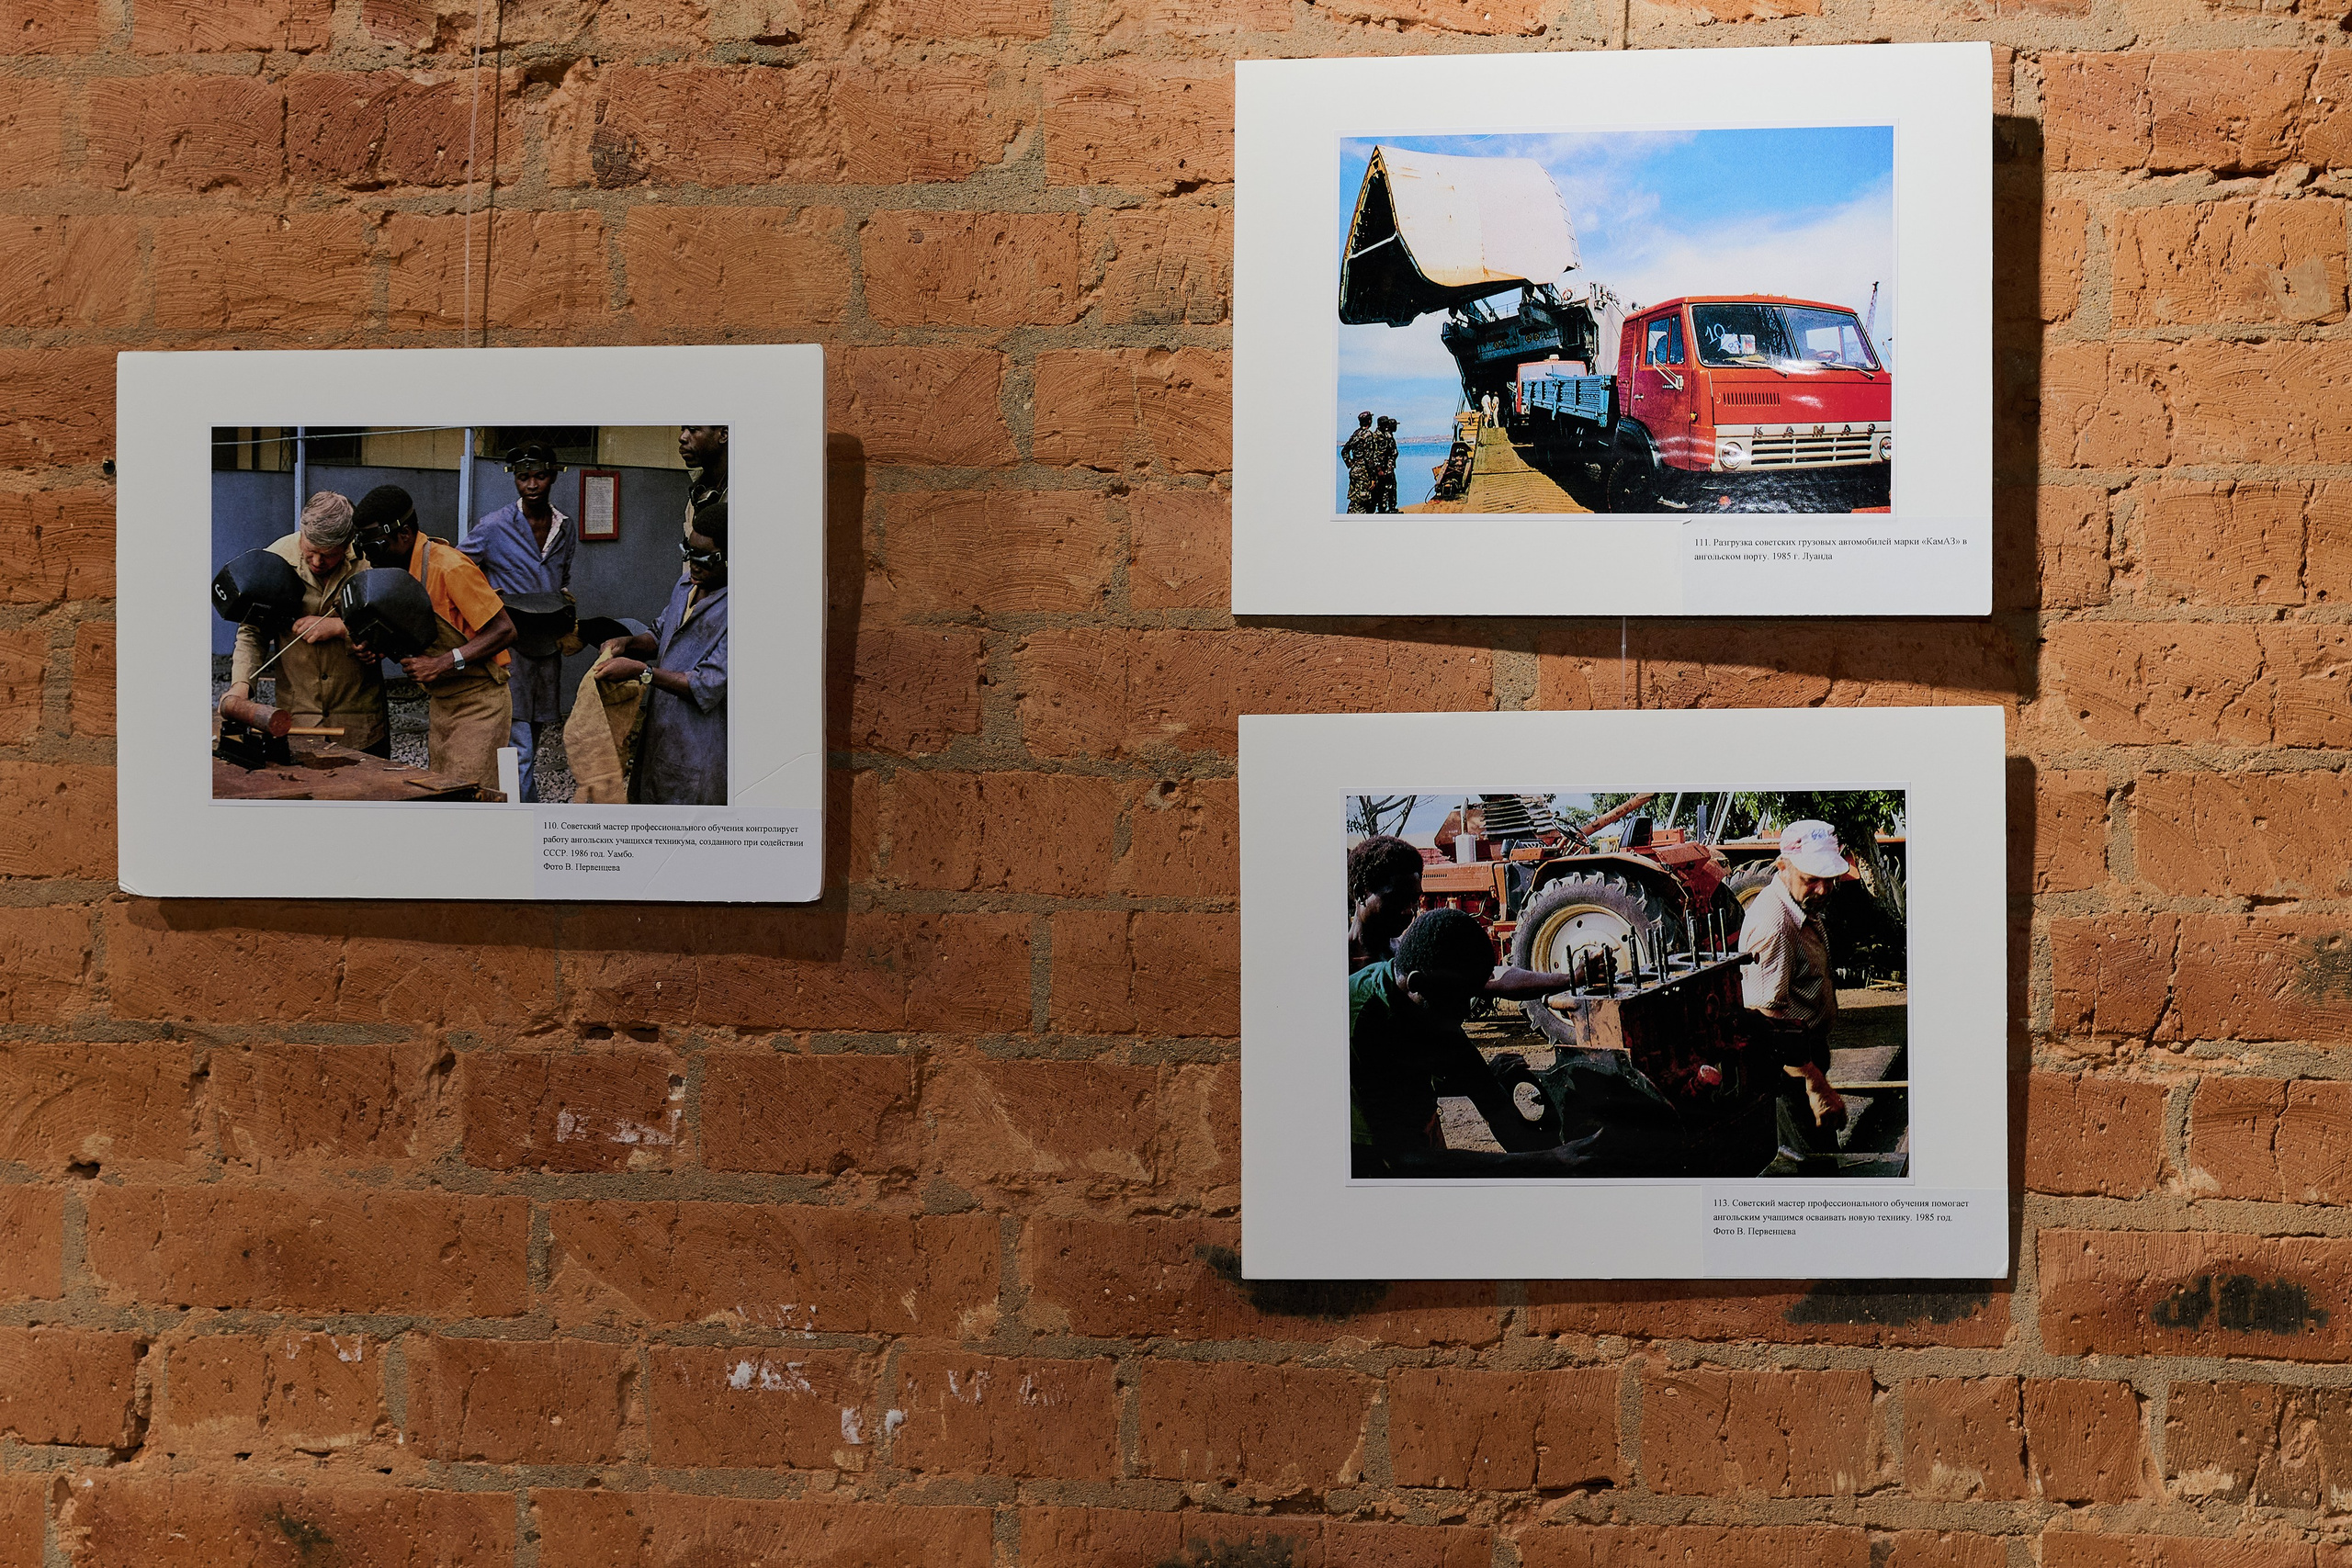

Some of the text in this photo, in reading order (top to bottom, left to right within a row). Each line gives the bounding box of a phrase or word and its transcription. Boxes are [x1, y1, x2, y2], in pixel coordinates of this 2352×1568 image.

[1695, 537, 1712, 547] 111.
[1713, 538, 1754, 549] Разгрузка
[1754, 539, 1796, 547] советских
[1798, 539, 1837, 548] грузовых
[1838, 536, 1892, 547] автомобилей
[1894, 539, 1919, 547] марки
[1921, 536, 1961, 546] «КамАЗ»
[1743, 554, 1770, 562] порту.
[1772, 551, 1792, 560] 1985
[1802, 551, 1833, 562] Луанда
[343, 583, 353, 608] 11
[544, 821, 799, 835] 110. Советский мастер профессионального обучения контролирует
[542, 835, 570, 845] работу
[615, 838, 653, 846] учащихся
[653, 838, 697, 847] техникума,
[743, 840, 759, 849] при
[759, 839, 804, 847] содействии
[542, 848, 569, 857] СССР.
[571, 849, 589, 858] 1986
[606, 850, 635, 859] Уамбо.
[543, 862, 564, 871] Фото
[575, 863, 621, 874] Первенцева
[1713, 1198, 1731, 1208] 113.
[1732, 1198, 1776, 1208] Советский
[1777, 1200, 1806, 1211] мастер
[1807, 1199, 1890, 1211] профессионального
[1889, 1199, 1929, 1211] обучения
[1762, 1214, 1804, 1224] учащимся
[1848, 1214, 1876, 1224] новую
[1876, 1214, 1913, 1224] технику.
[1916, 1213, 1935, 1222] 1985
[1936, 1214, 1953, 1223] год.
[1713, 1226, 1736, 1235] Фото
[1747, 1226, 1797, 1237] Первенцева
